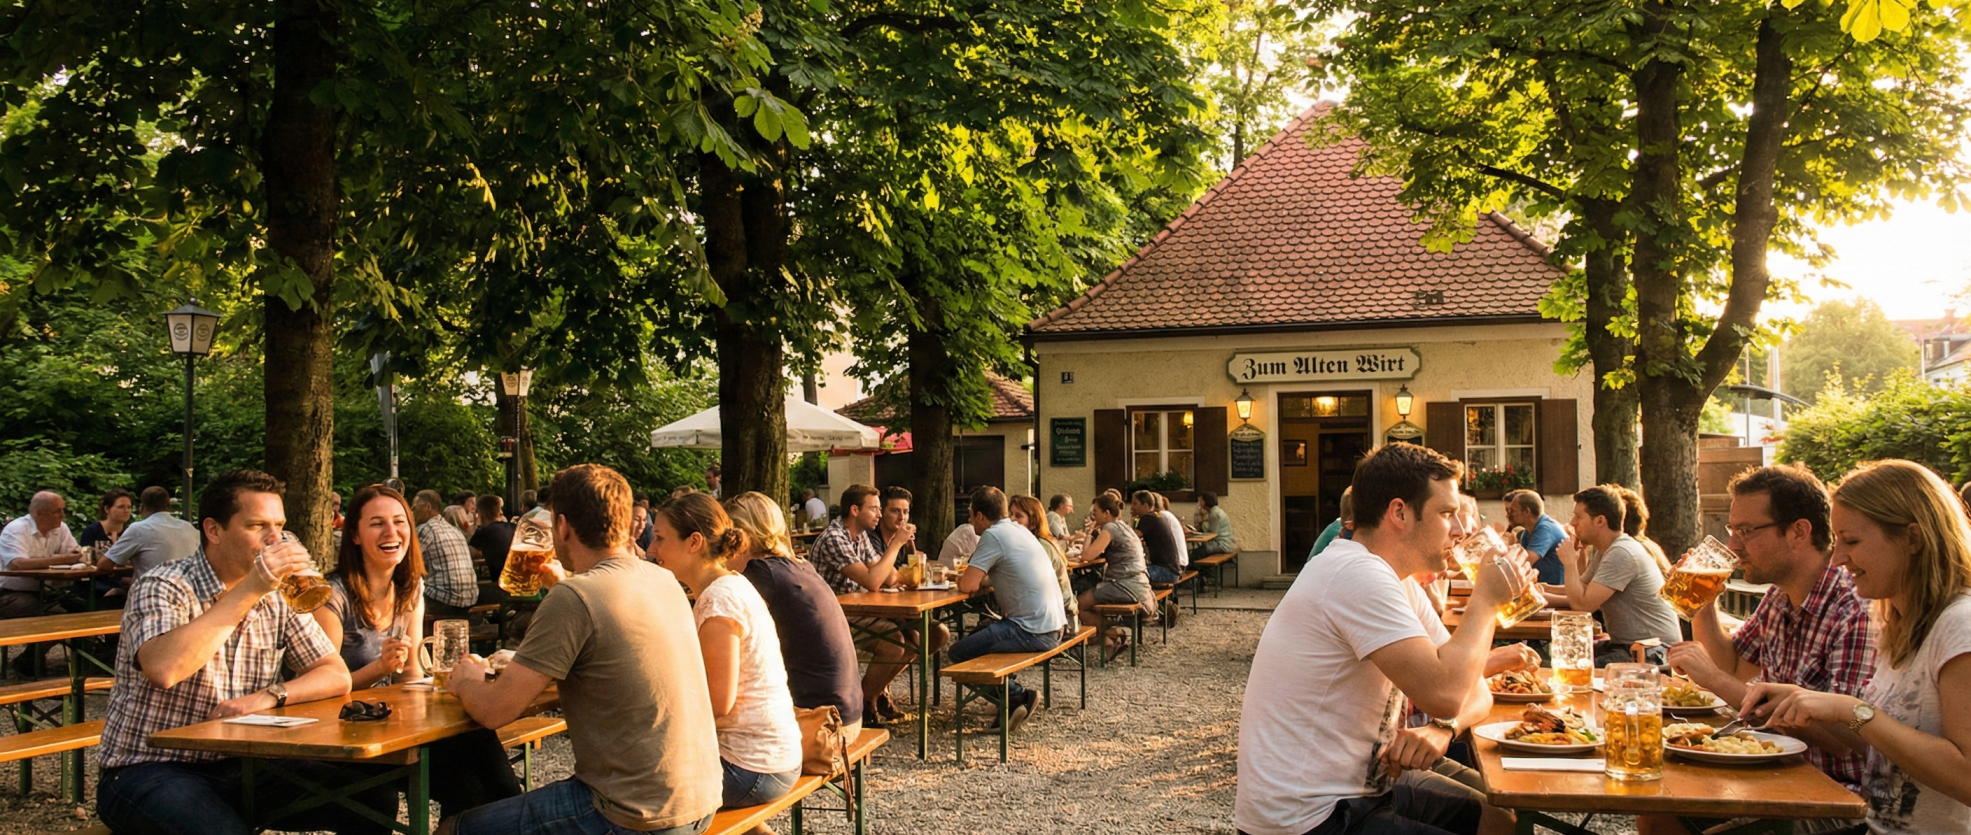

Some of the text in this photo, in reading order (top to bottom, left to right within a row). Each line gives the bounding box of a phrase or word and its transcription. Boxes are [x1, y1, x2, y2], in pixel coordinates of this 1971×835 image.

[1241, 354, 1405, 380] Zum Alten Wirt
